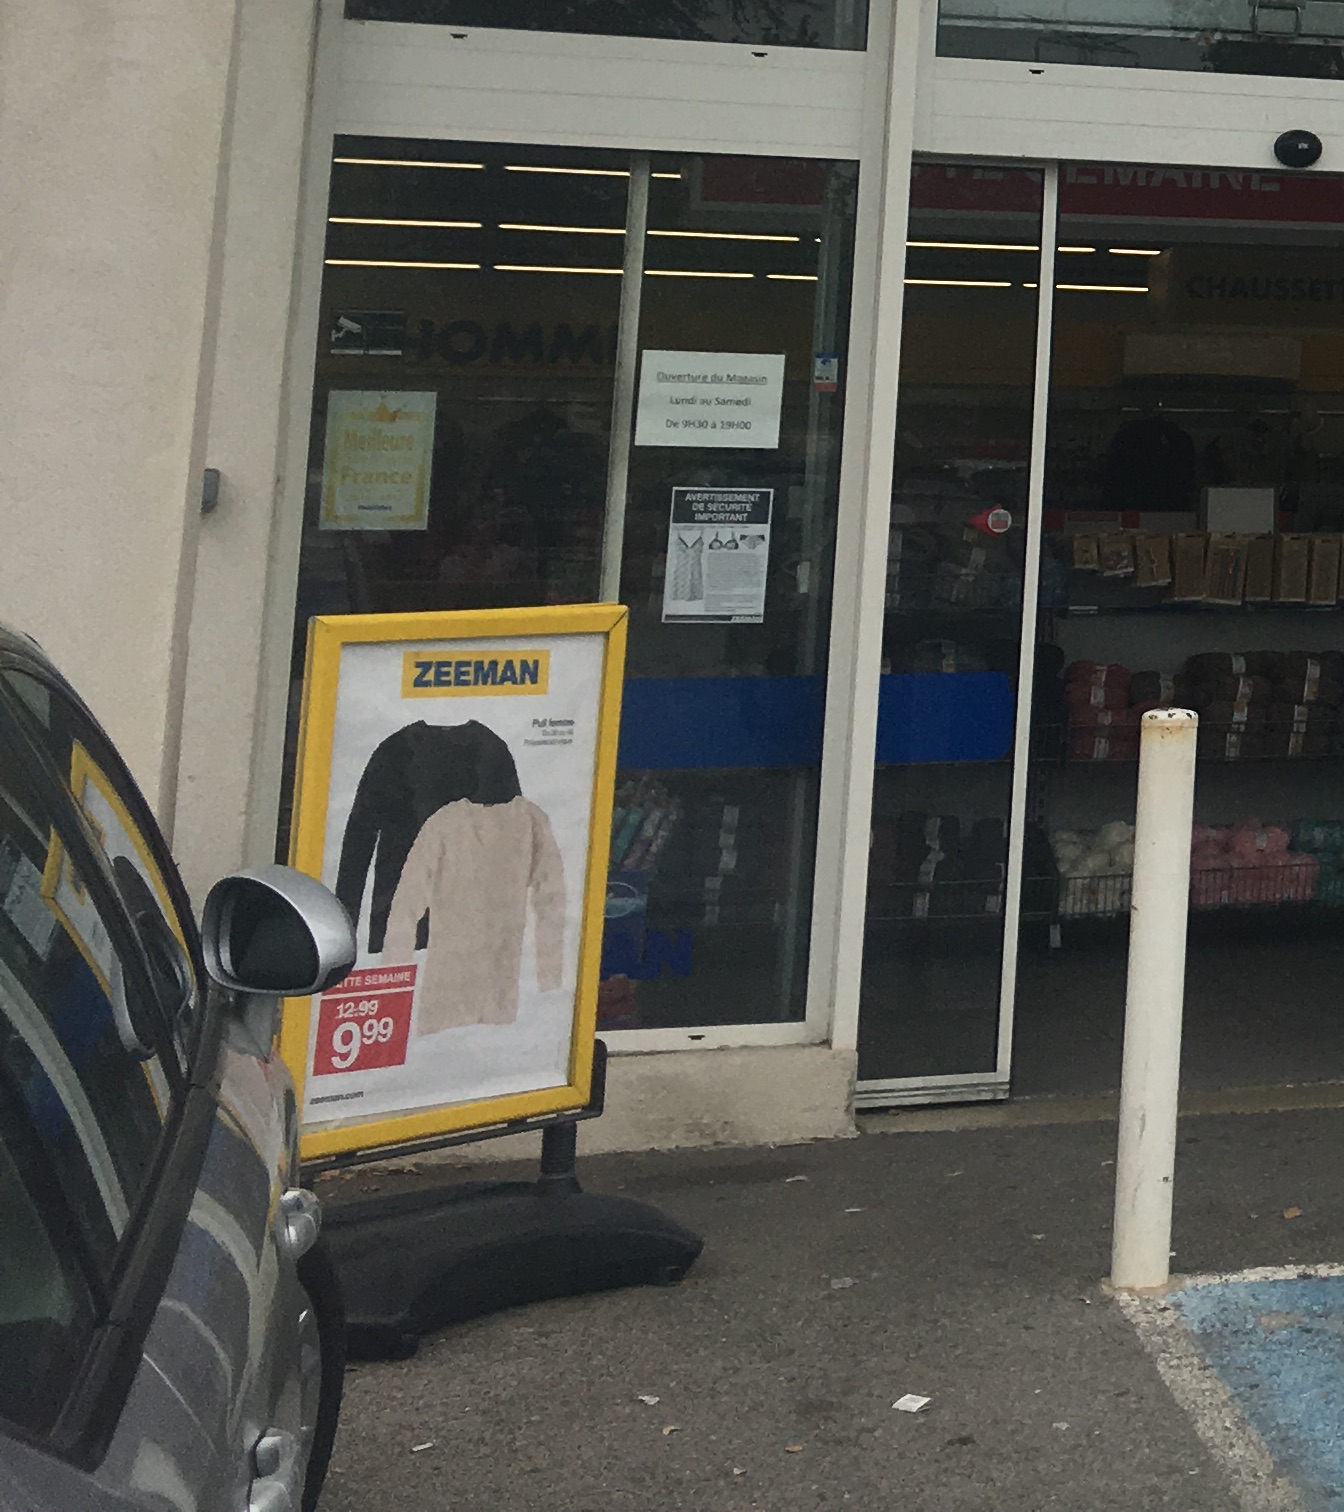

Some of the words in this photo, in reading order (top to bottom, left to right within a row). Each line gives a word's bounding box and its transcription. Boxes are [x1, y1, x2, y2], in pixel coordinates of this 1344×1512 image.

[669, 395, 697, 405] Lundi
[699, 398, 712, 406] au
[714, 396, 752, 407] Samedi
[665, 418, 679, 428] De
[694, 512, 748, 522] IMPORTANT
[412, 658, 540, 688] ZEEMAN
[364, 971, 411, 986] SEMAINE
